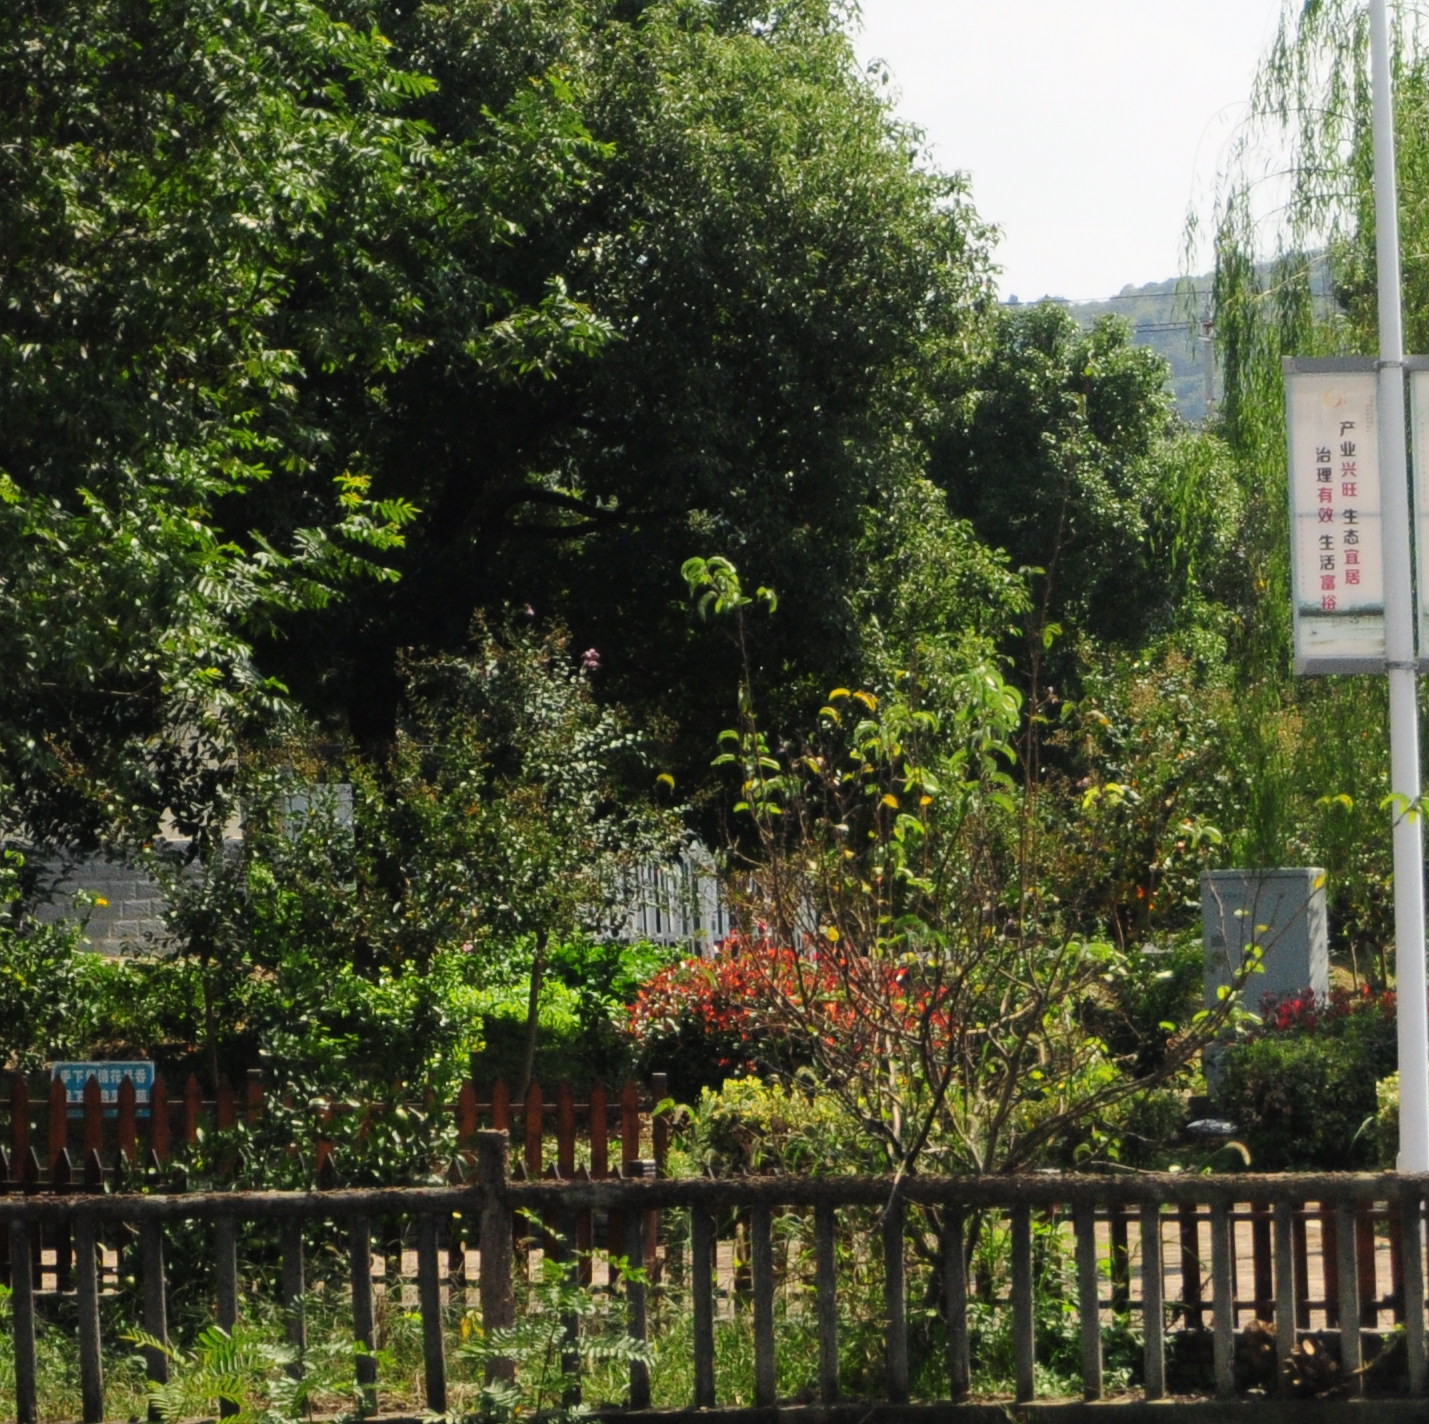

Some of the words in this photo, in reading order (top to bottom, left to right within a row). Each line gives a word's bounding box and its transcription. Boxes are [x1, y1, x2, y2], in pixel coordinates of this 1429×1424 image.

[1316, 446, 1333, 523] 治理有效
[1339, 420, 1358, 497] 产业兴旺
[1318, 534, 1337, 611] 生活富裕
[1343, 509, 1361, 586] 生态宜居
